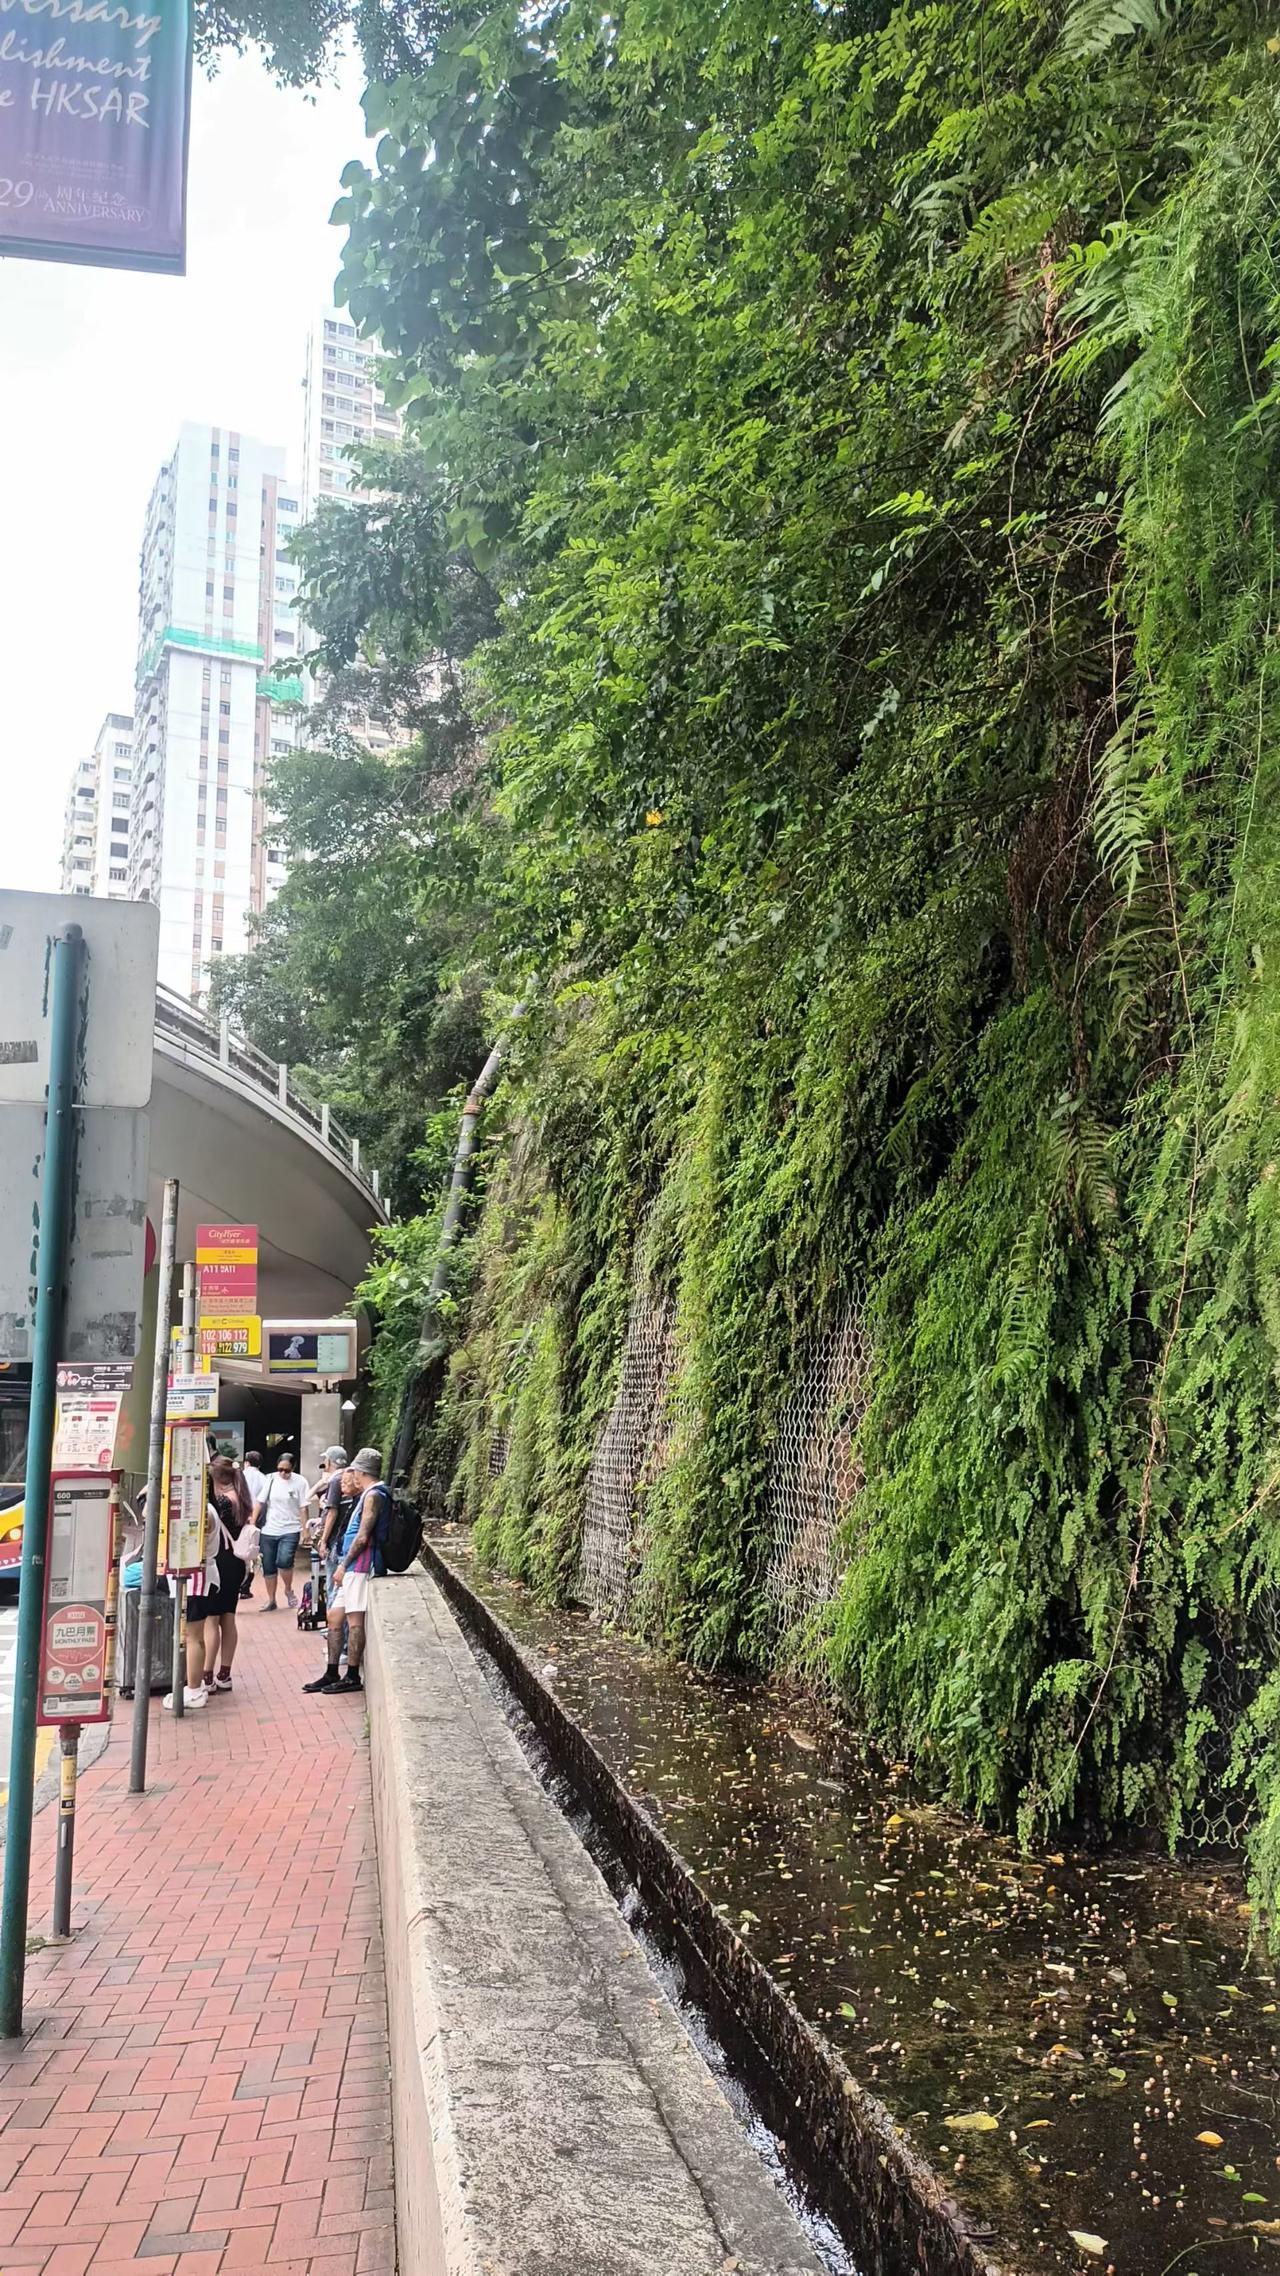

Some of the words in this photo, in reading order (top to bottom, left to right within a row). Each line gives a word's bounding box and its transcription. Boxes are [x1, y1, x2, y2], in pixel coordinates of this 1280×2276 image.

[31, 78, 150, 128] HKSAR
[43, 197, 145, 222] ANNIVERSARY
[202, 1329, 216, 1340] 102
[219, 1329, 232, 1340] 106
[234, 1328, 248, 1339] 112
[202, 1342, 216, 1353] 116
[233, 1342, 247, 1353] 979
